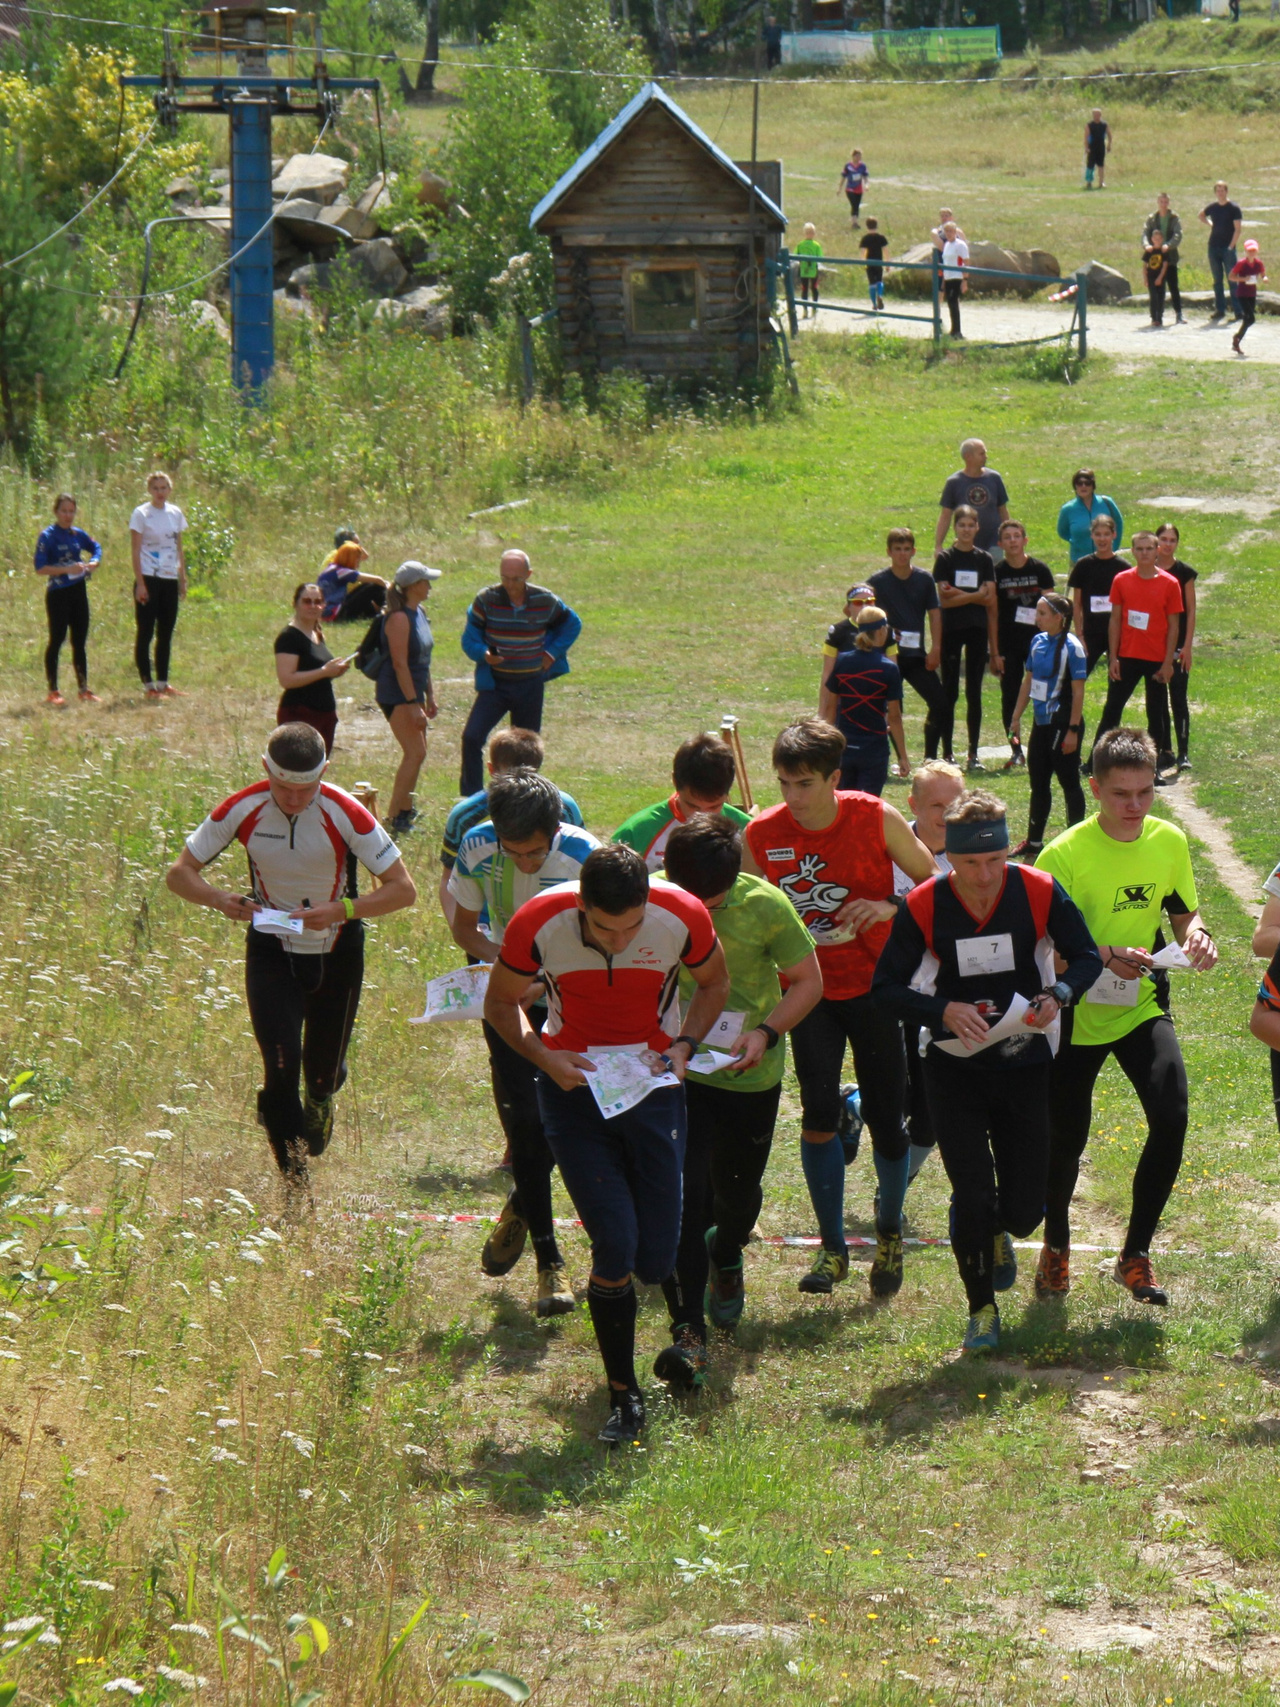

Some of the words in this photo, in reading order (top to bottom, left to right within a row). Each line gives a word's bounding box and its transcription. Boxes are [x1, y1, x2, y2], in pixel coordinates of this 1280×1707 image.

[991, 942, 999, 953] 7
[1112, 980, 1127, 991] 15
[720, 1021, 729, 1032] 8
